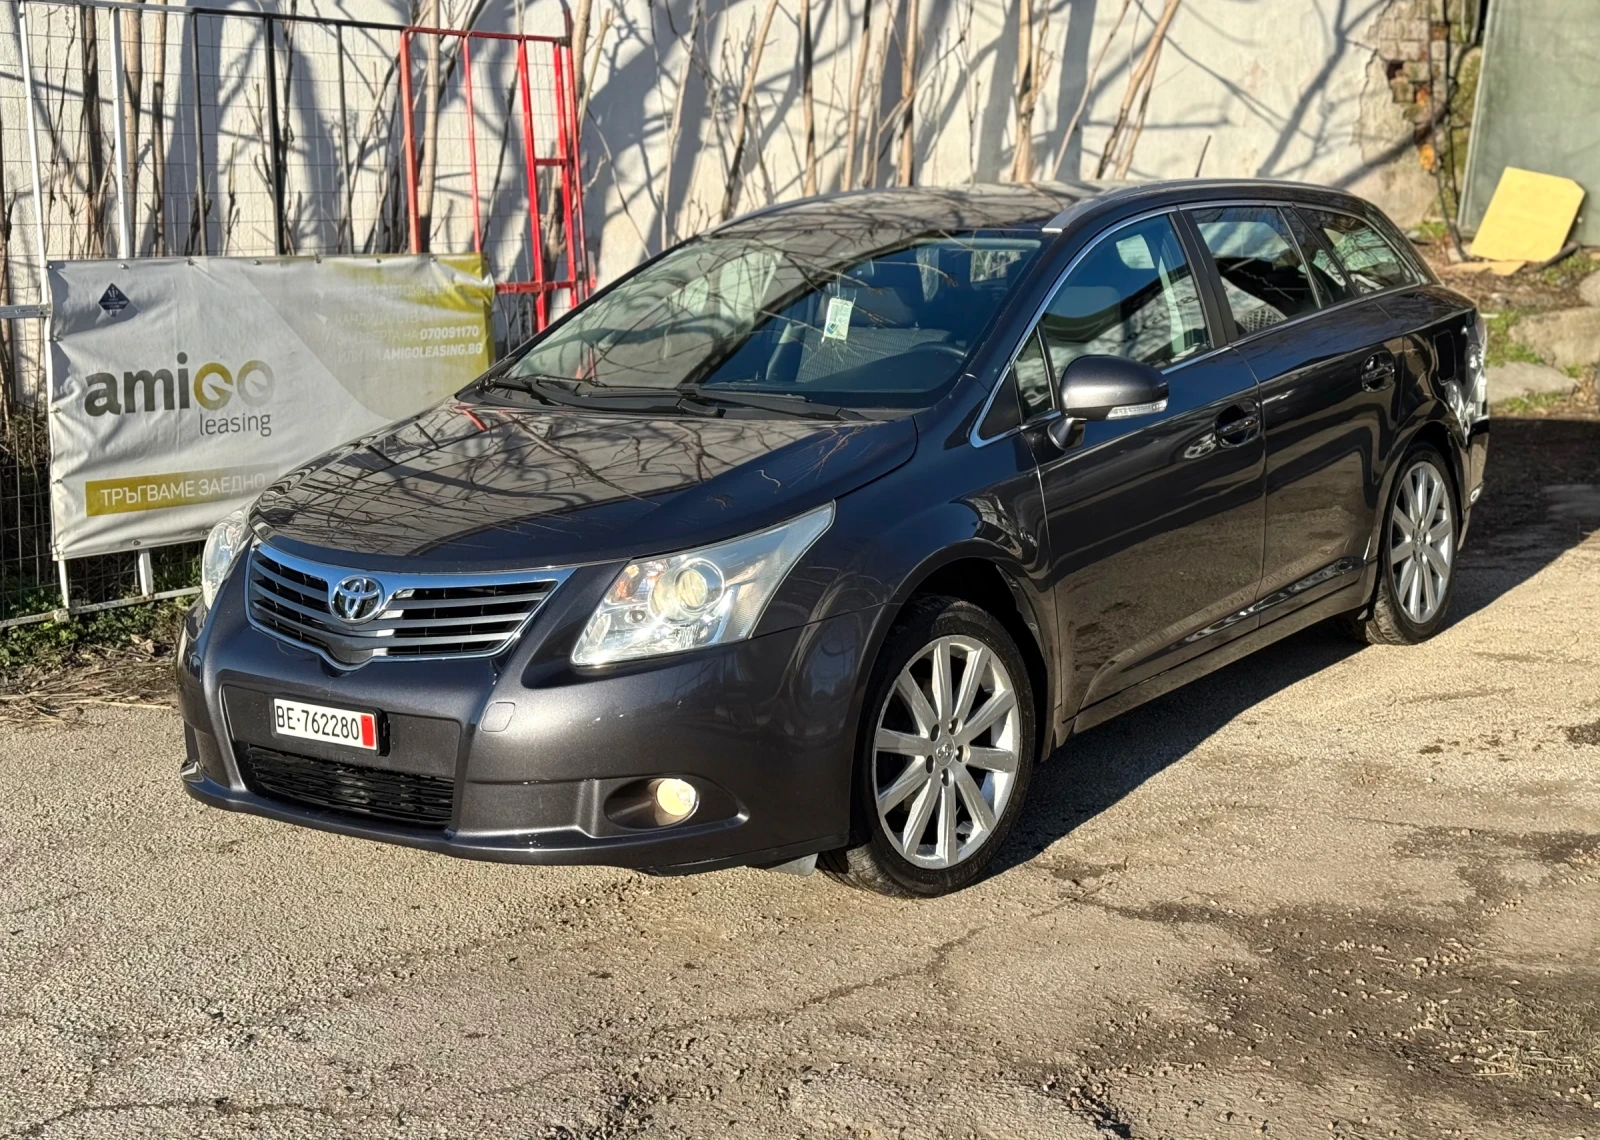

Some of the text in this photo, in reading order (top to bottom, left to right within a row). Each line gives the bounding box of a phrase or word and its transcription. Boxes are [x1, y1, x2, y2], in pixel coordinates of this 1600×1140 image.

[420, 325, 479, 341] 070091170
[383, 342, 482, 361] AMIGOLEASING.BG
[200, 413, 272, 437] leasing
[101, 473, 266, 506] ТРЪГВАМЕ ЗАЕДНО
